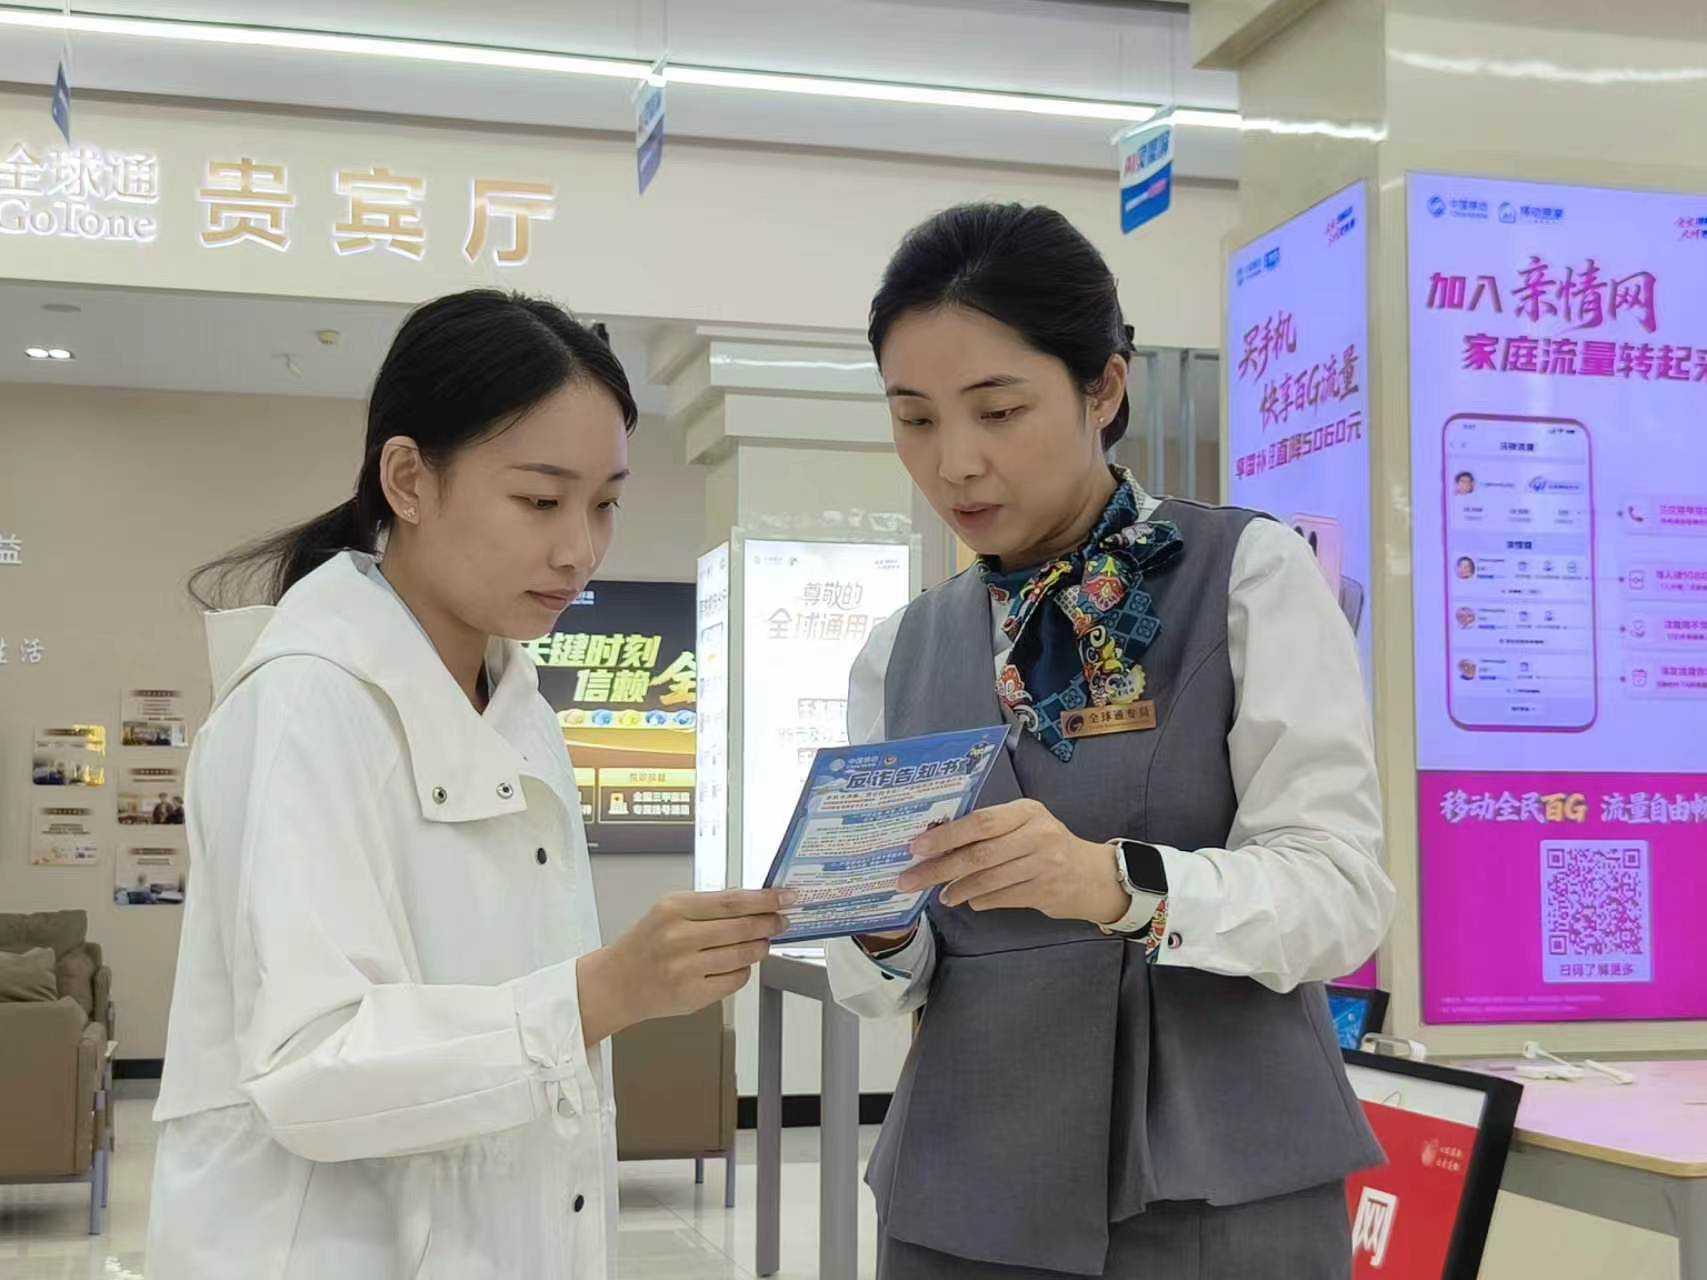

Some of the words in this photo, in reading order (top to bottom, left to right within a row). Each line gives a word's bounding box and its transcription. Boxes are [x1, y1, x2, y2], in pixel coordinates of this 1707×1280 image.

[0, 144, 158, 202] 全球通
[0, 198, 156, 241] GoTone
[198, 156, 556, 266] 贵宾厅
[1426, 256, 1657, 334] 加入亲情网
[801, 581, 863, 611] 尊敬的
[574, 669, 650, 702] 信赖
[846, 757, 964, 789] 反诈告知书
[1440, 790, 1587, 823] 移动全民百G
[1560, 963, 1634, 977] 扫码了解更多
[1352, 1186, 1398, 1269] 网
